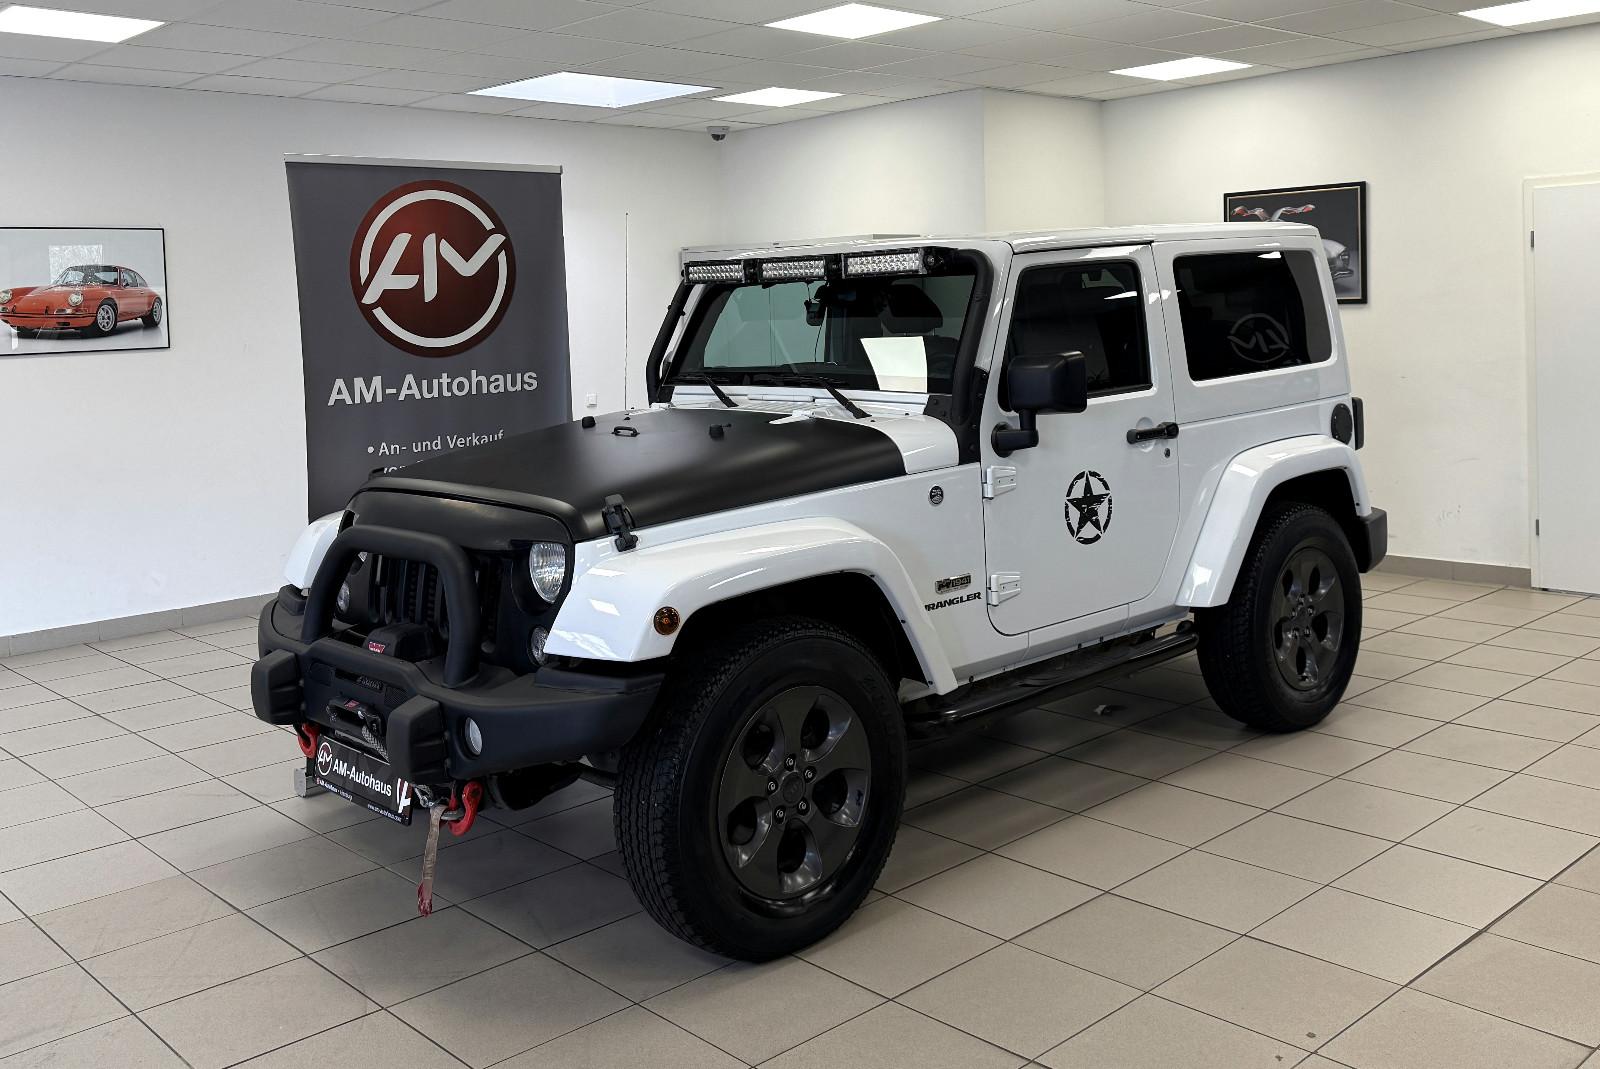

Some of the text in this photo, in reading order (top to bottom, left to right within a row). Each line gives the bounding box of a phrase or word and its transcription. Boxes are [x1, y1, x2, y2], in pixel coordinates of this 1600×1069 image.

[327, 369, 539, 406] AM-Autohaus
[378, 442, 407, 456] An-
[412, 435, 442, 453] und
[332, 758, 392, 797] AM-Autohaus
